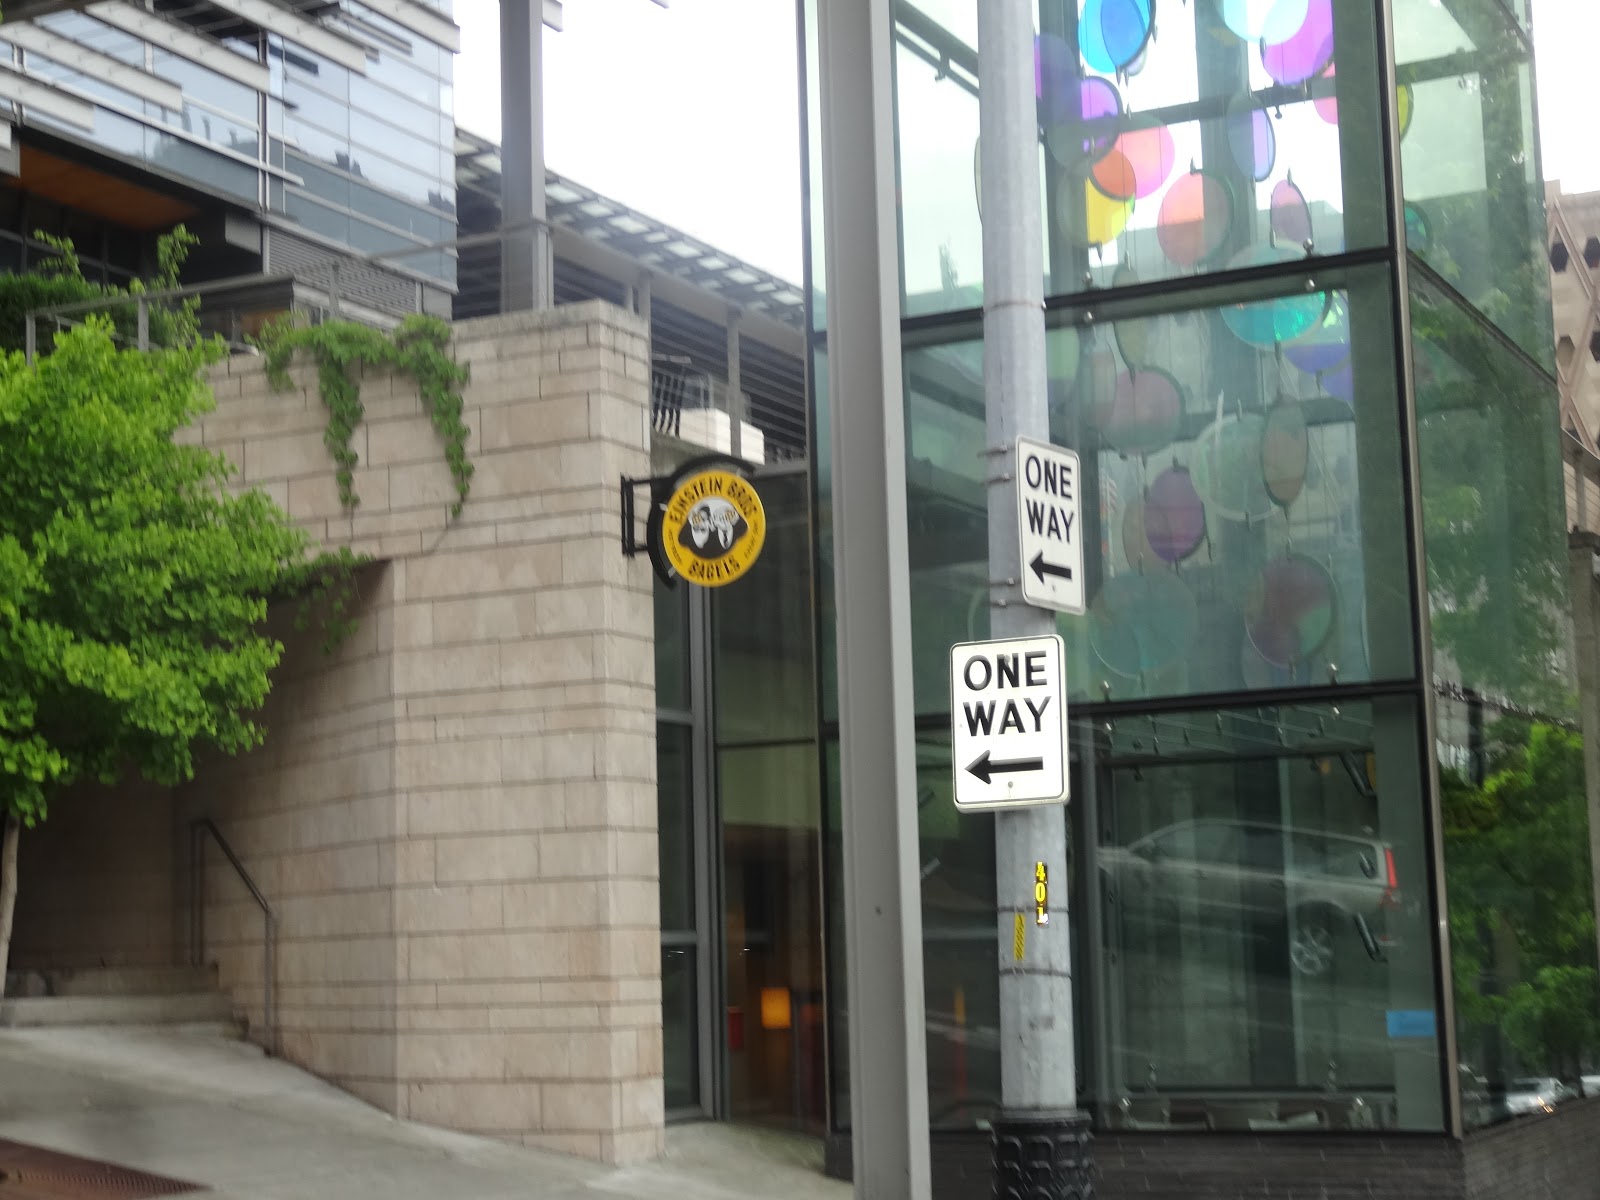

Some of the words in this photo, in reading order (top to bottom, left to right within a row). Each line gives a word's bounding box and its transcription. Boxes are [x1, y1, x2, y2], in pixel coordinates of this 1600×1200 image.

[1025, 455, 1073, 500] ONE
[668, 475, 723, 525] EINSTEIN
[1026, 499, 1075, 544] WAY
[688, 554, 740, 581] BAGELS
[963, 650, 1048, 691] ONE
[963, 695, 1051, 737] WAY
